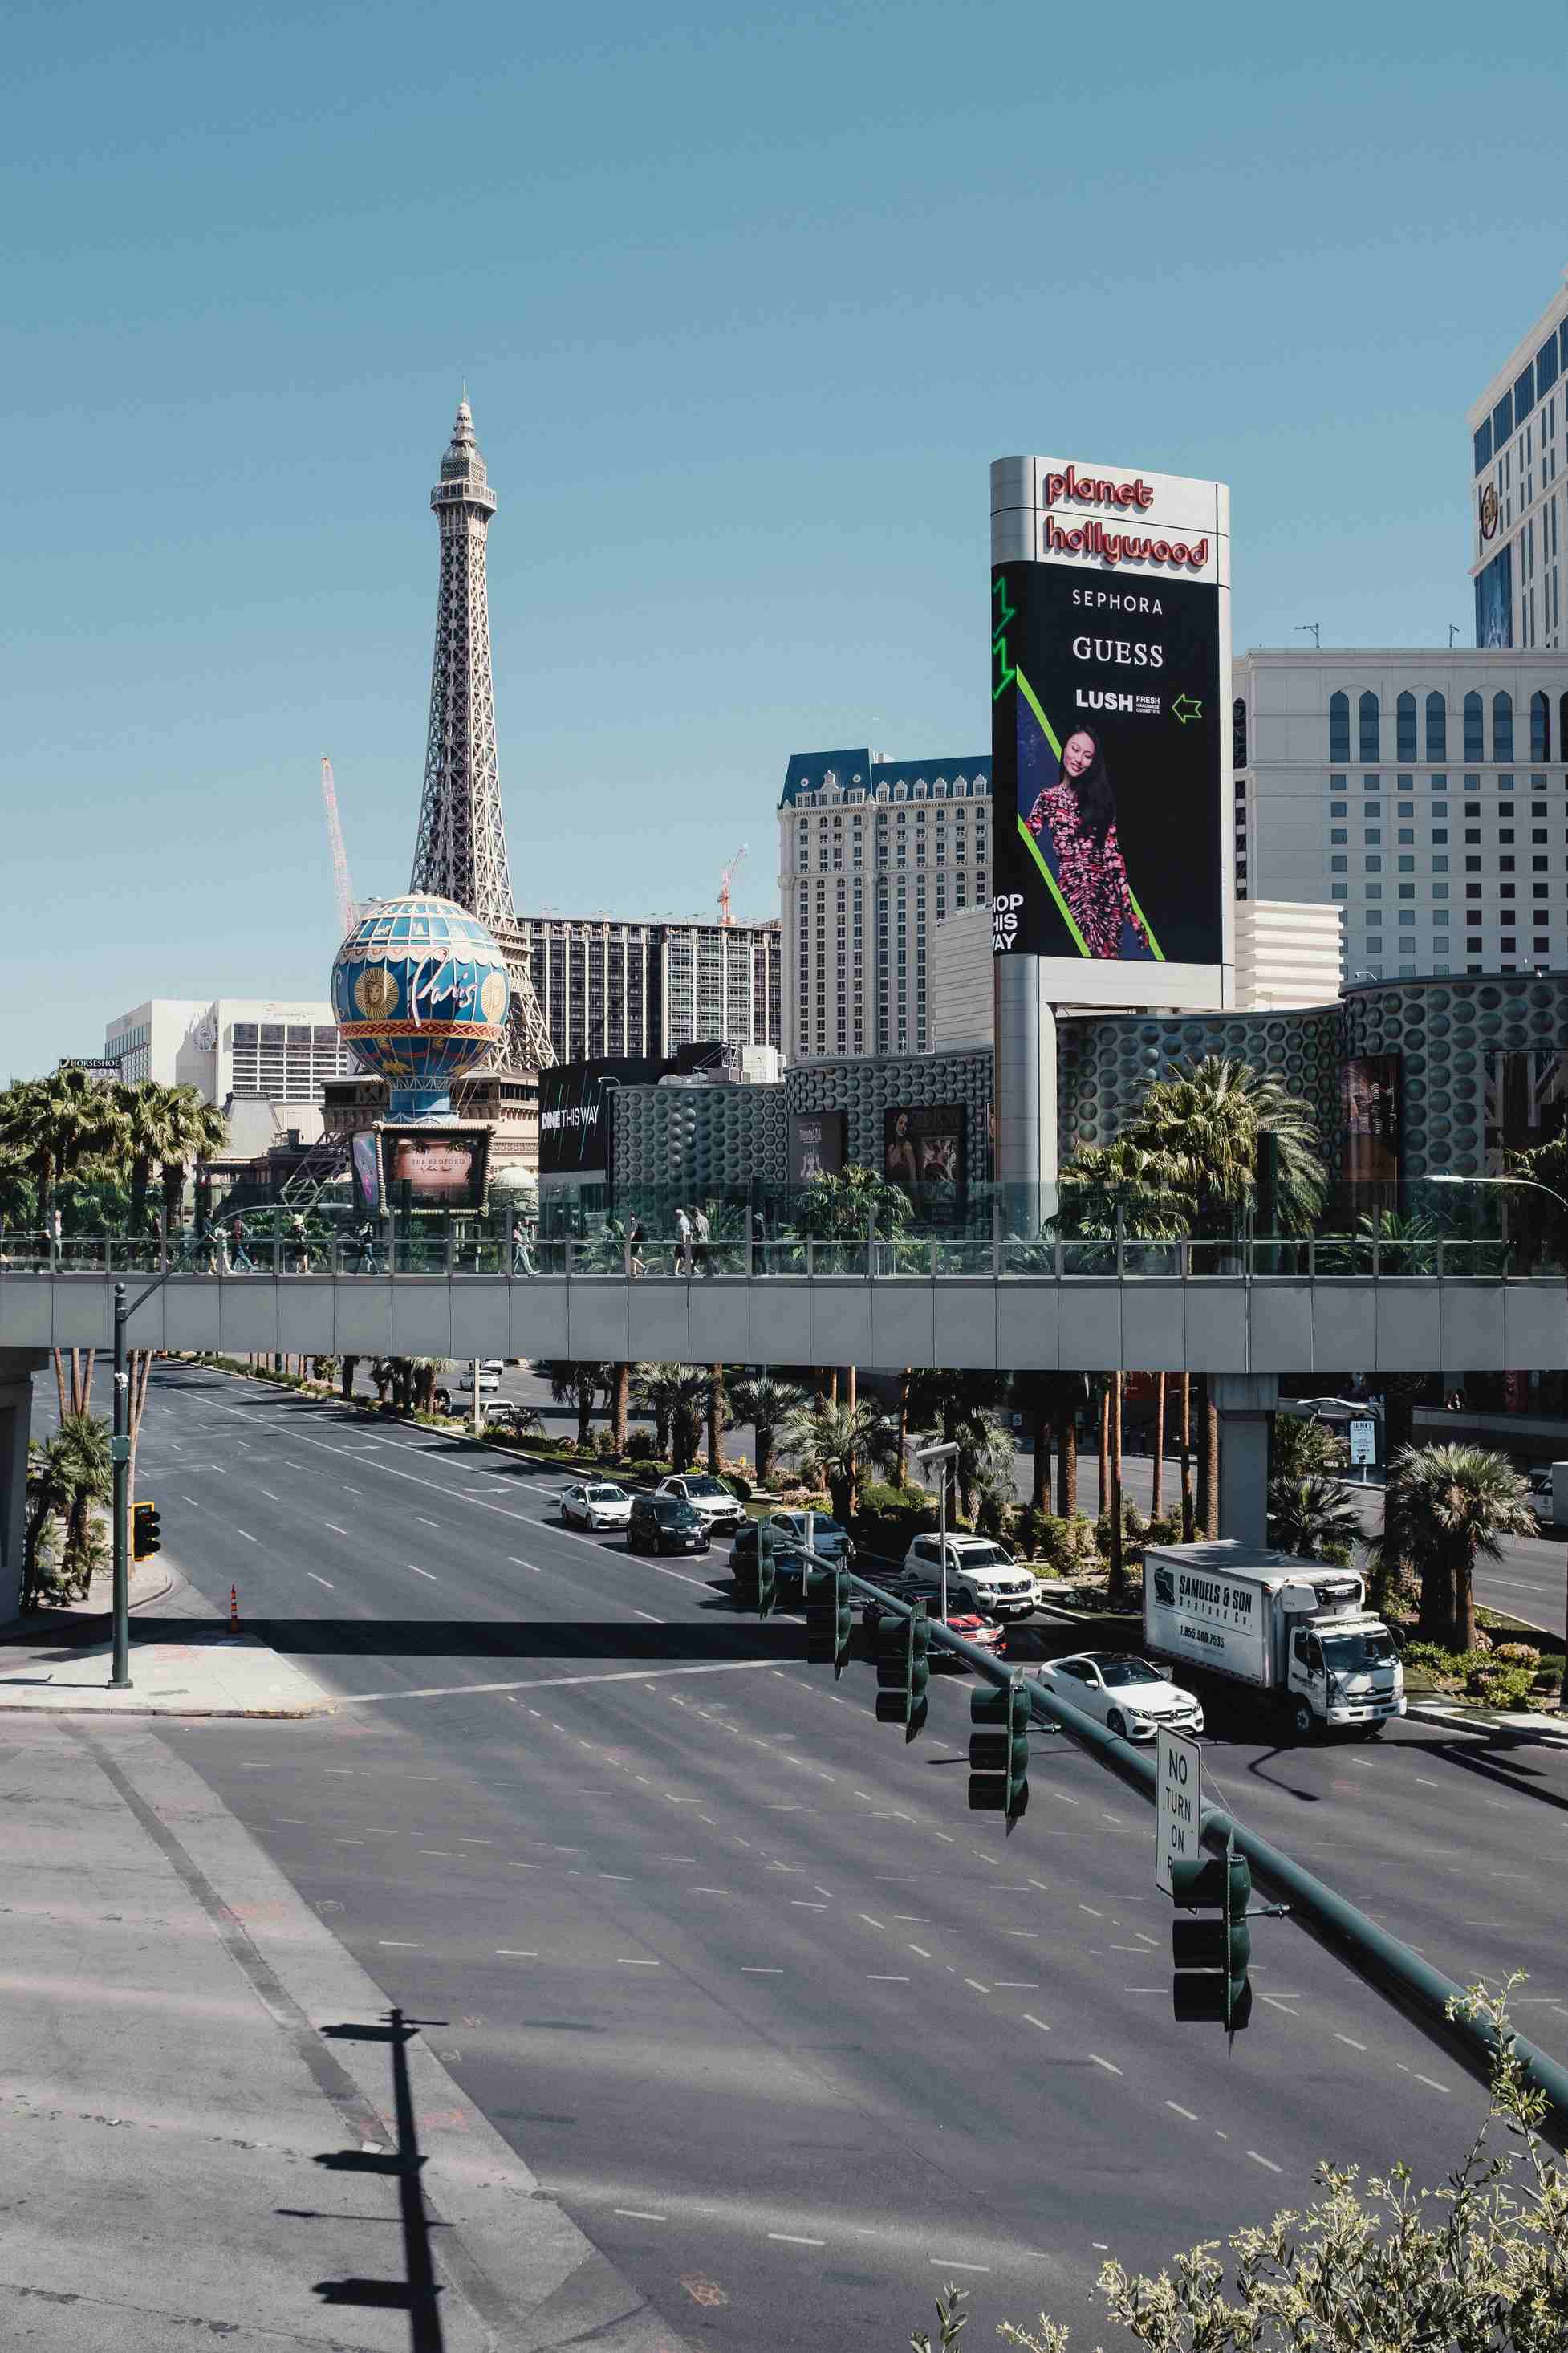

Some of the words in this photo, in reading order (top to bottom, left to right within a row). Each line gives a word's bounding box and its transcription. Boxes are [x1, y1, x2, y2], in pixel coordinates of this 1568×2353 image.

[1046, 465, 1154, 507] planet
[1046, 515, 1208, 567] hollywood
[1073, 589, 1163, 616] SEPHORA
[1072, 636, 1164, 668] GUESS
[1076, 689, 1133, 712] LUSH
[1135, 696, 1160, 705] FRESH
[992, 913, 1018, 932] HIS
[992, 933, 1018, 951] AY
[412, 947, 480, 1028] Paris
[542, 1111, 561, 1130] DINE
[561, 1107, 579, 1128] THIS
[580, 1104, 599, 1124] WAY
[1180, 1575, 1221, 1604] SAMUELS
[1223, 1587, 1230, 1607] &
[1233, 1589, 1253, 1614] SON
[1169, 1748, 1188, 1786] NO
[1166, 1786, 1192, 1823] TURN
[1171, 1824, 1184, 1854] ON
